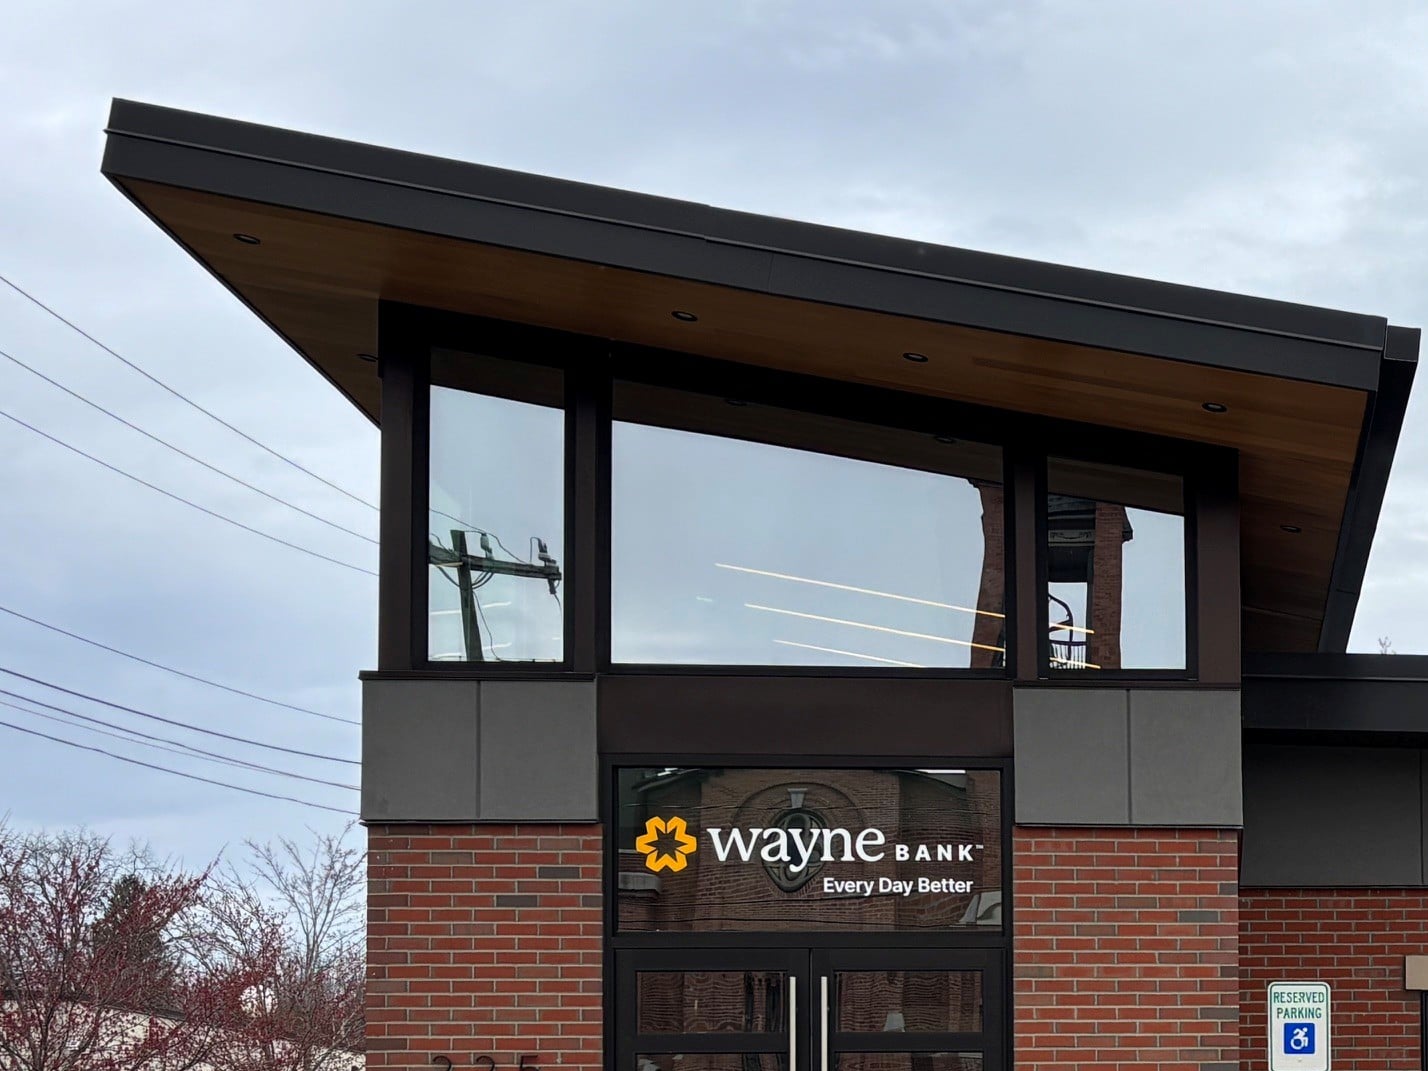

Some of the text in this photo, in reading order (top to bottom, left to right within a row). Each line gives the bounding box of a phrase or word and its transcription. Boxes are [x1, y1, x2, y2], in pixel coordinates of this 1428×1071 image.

[706, 826, 886, 873] wayne
[823, 877, 974, 896] Every Day Better
[1273, 991, 1325, 1003] RESERVED
[1276, 1007, 1322, 1019] PARKING
